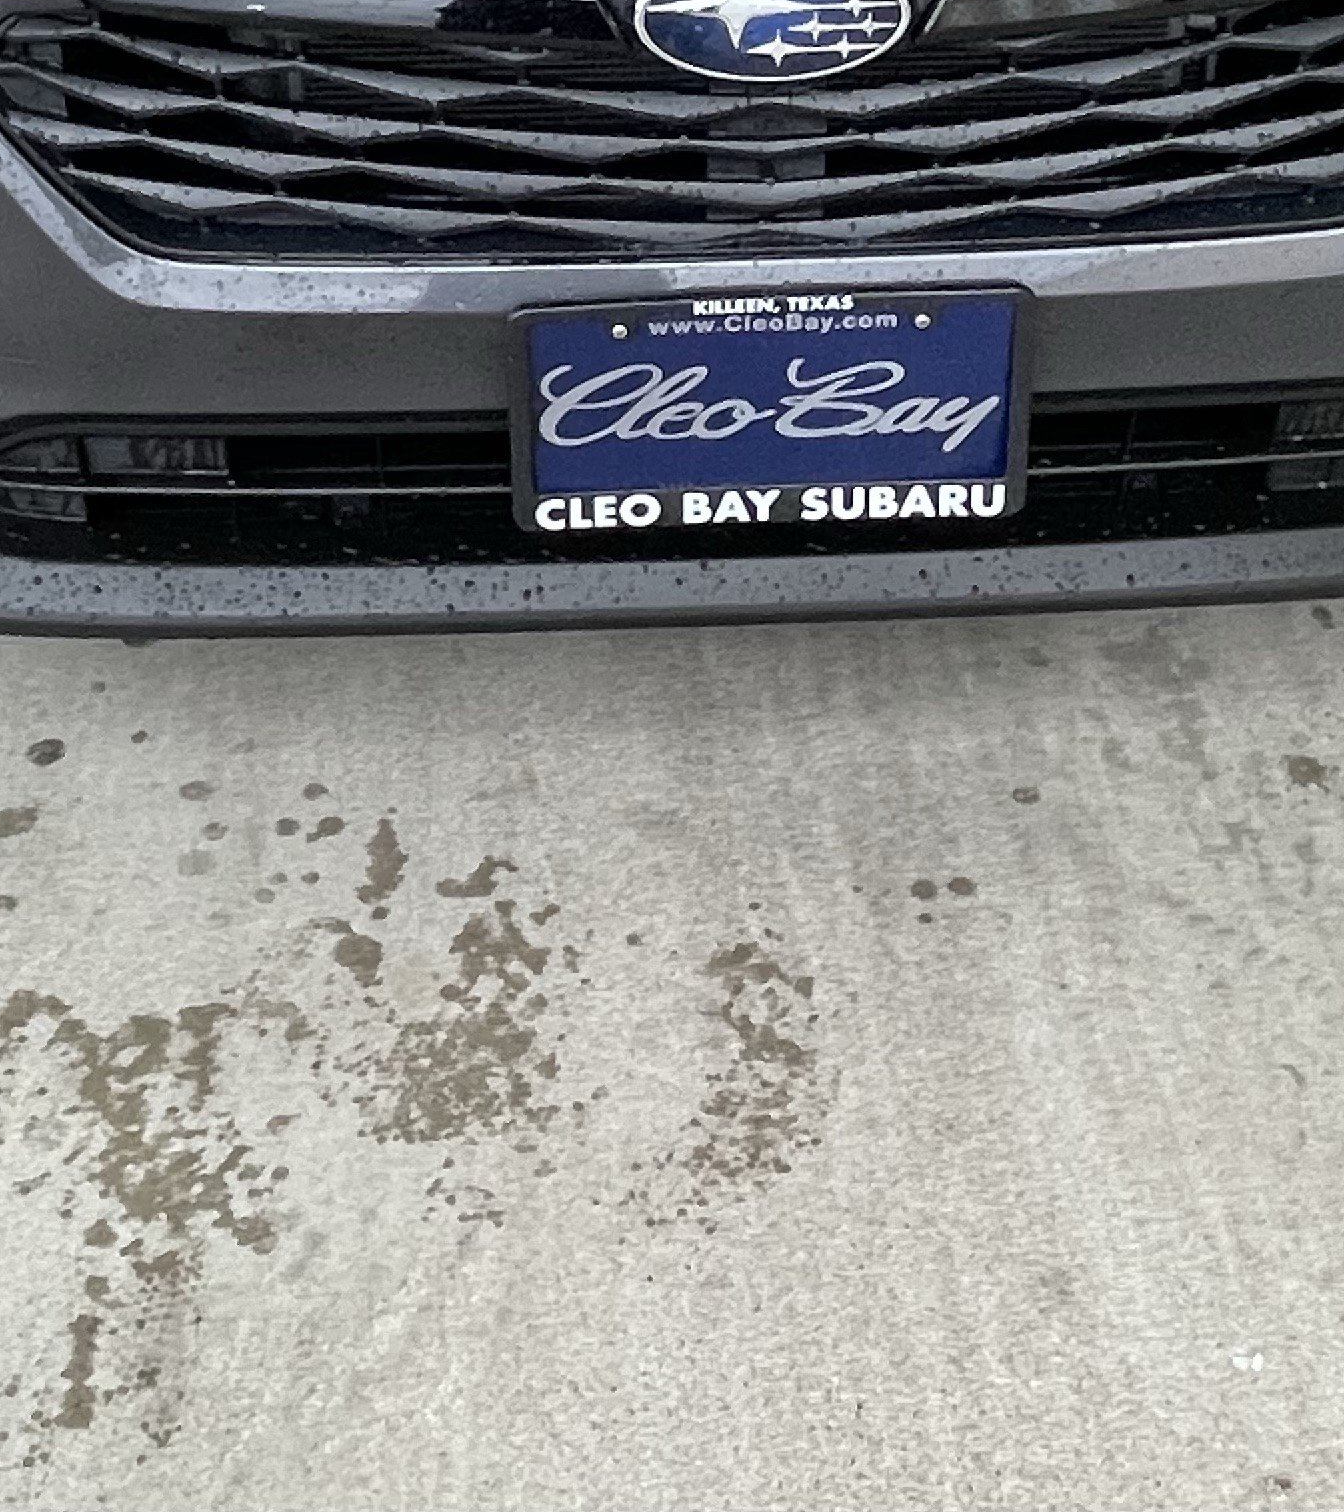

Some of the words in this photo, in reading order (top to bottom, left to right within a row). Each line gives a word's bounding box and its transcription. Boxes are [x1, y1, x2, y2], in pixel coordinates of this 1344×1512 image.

[786, 294, 854, 312] TEXAS
[648, 312, 898, 336] www.CleoBay.com
[539, 363, 777, 447] Cleo
[773, 358, 1001, 452] Bay
[534, 494, 662, 531] CLEO
[682, 488, 781, 525] BAY
[800, 483, 1008, 522] SUBARU
